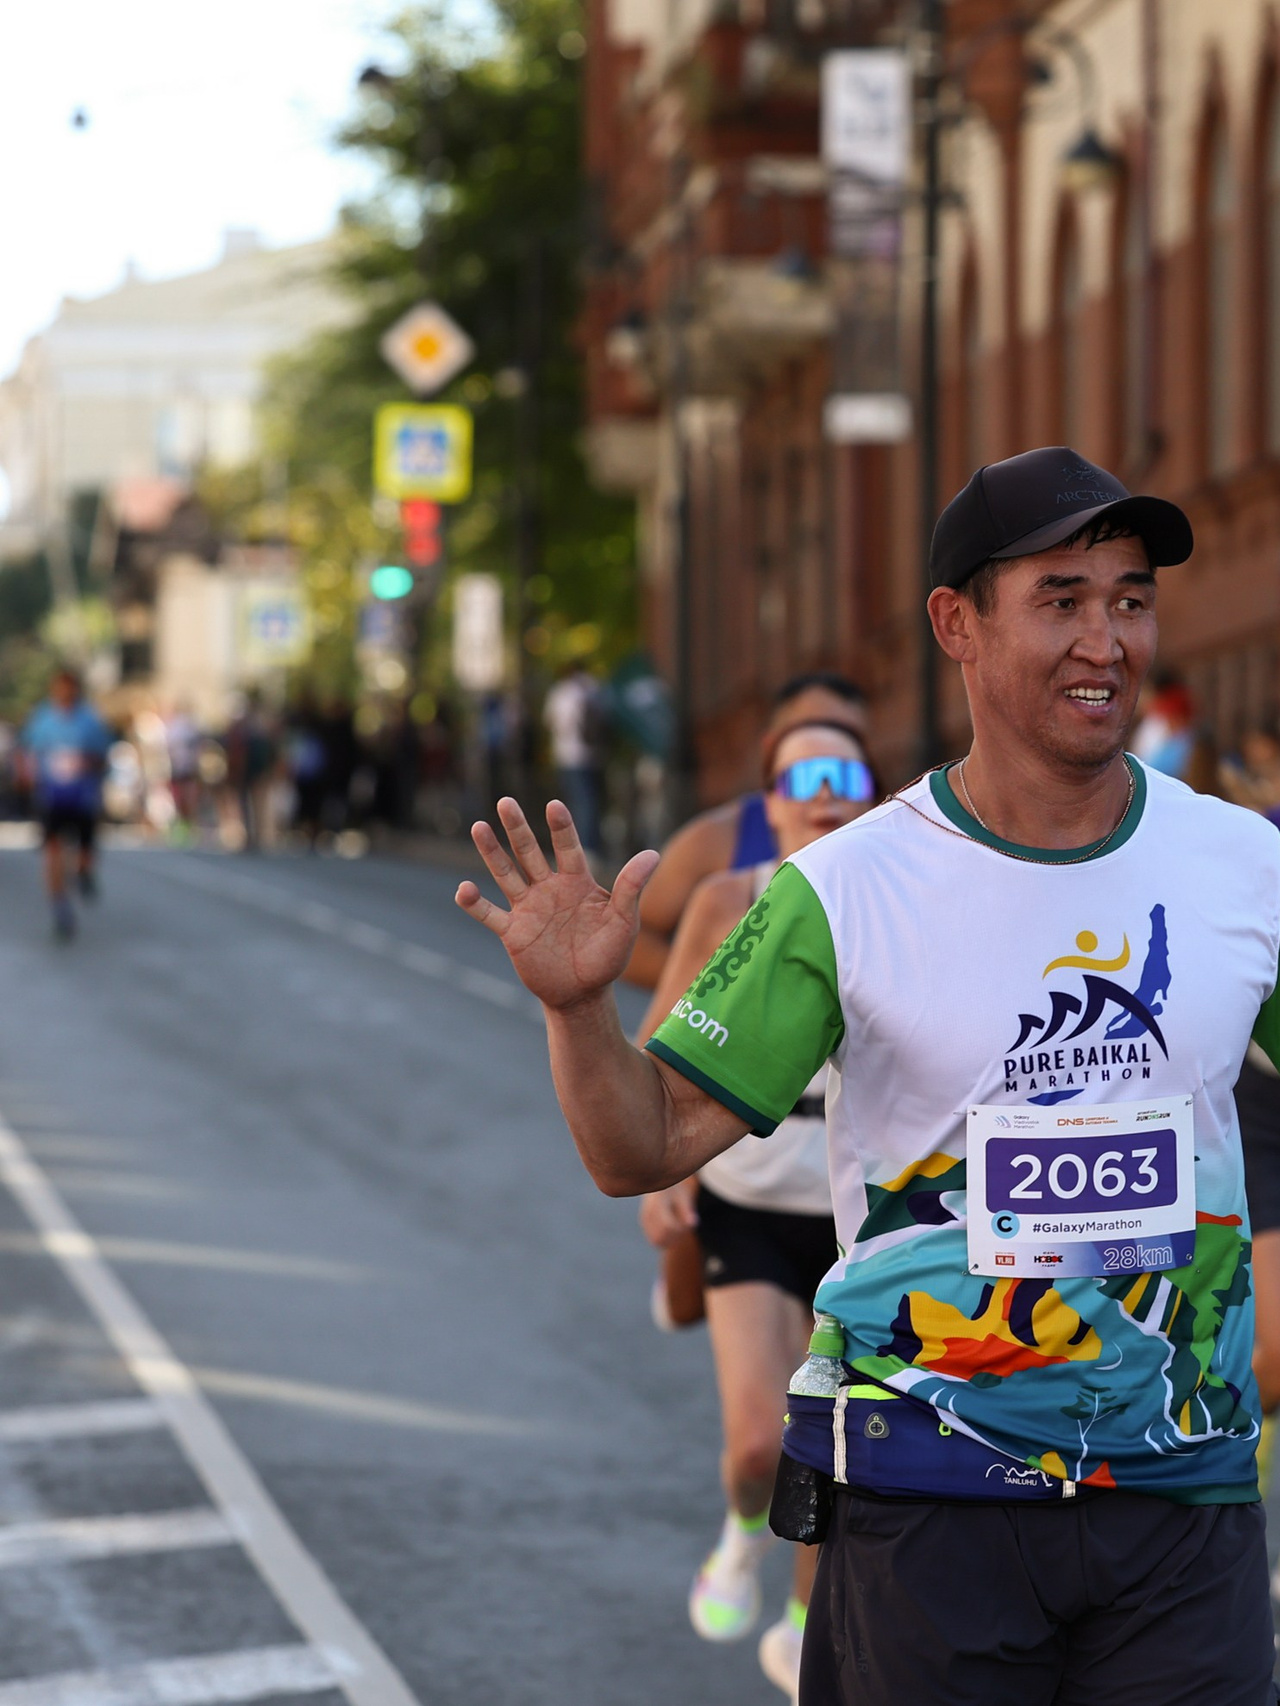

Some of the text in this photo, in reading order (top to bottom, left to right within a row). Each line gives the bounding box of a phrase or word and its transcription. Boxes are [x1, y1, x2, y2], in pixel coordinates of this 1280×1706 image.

[1004, 1043, 1151, 1079] PURE BAIKAL
[1005, 1067, 1151, 1092] MARATHON
[1057, 1118, 1084, 1126] DNS
[1009, 1147, 1159, 1200] 2063
[997, 1216, 1013, 1233] C
[1032, 1219, 1142, 1234] #GalaxyMarathon
[1103, 1245, 1173, 1270] 28km
[1003, 1476, 1038, 1486] TANLUHU
